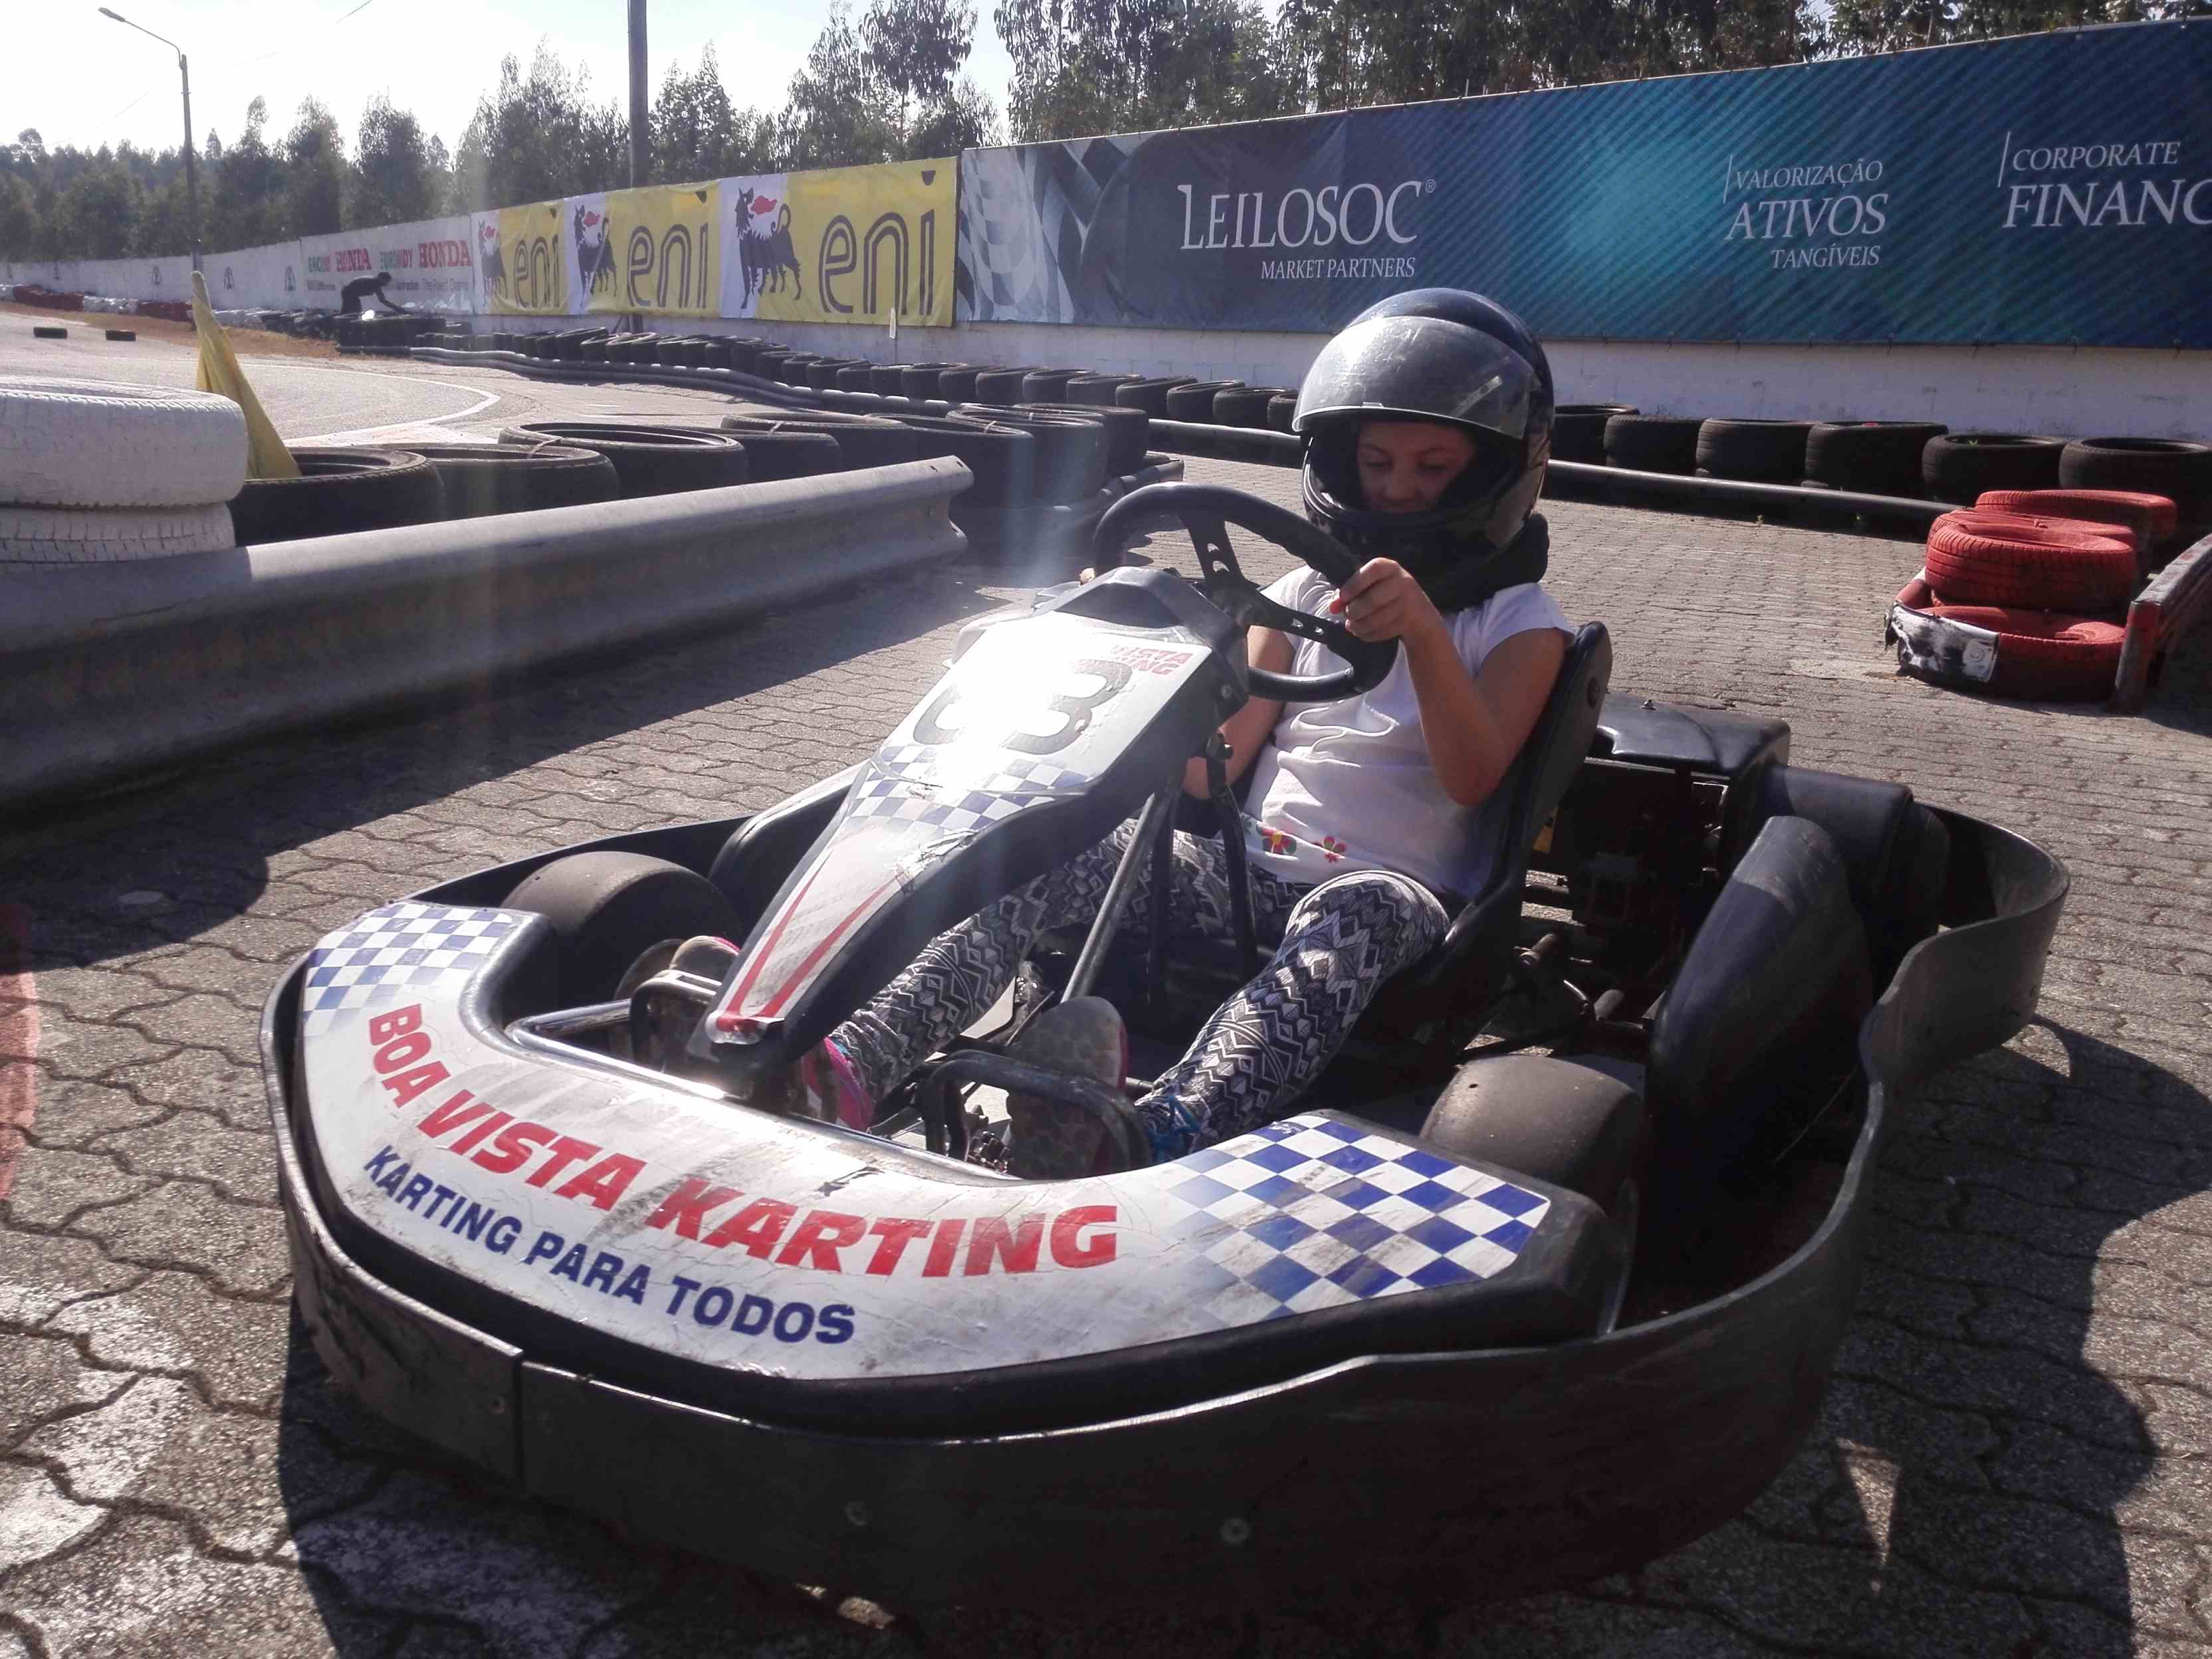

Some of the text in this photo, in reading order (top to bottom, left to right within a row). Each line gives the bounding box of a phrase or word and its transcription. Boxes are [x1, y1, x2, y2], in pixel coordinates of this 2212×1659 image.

[1736, 158, 1883, 189] VALORIZAÇÃO
[2013, 142, 2181, 171] CORPORATE
[1724, 193, 1888, 240] ATIVOS
[418, 240, 473, 269] HONDA
[513, 208, 560, 308] eni
[627, 191, 709, 308] eni
[818, 170, 937, 316] eni
[1771, 243, 1881, 269] TANGÍVEIS
[1261, 257, 1416, 279] MARKET PARTNERS
[368, 1003, 1117, 1278] BOA VISTA KARTING
[363, 1145, 855, 1345] KARTING PARA TODOS
